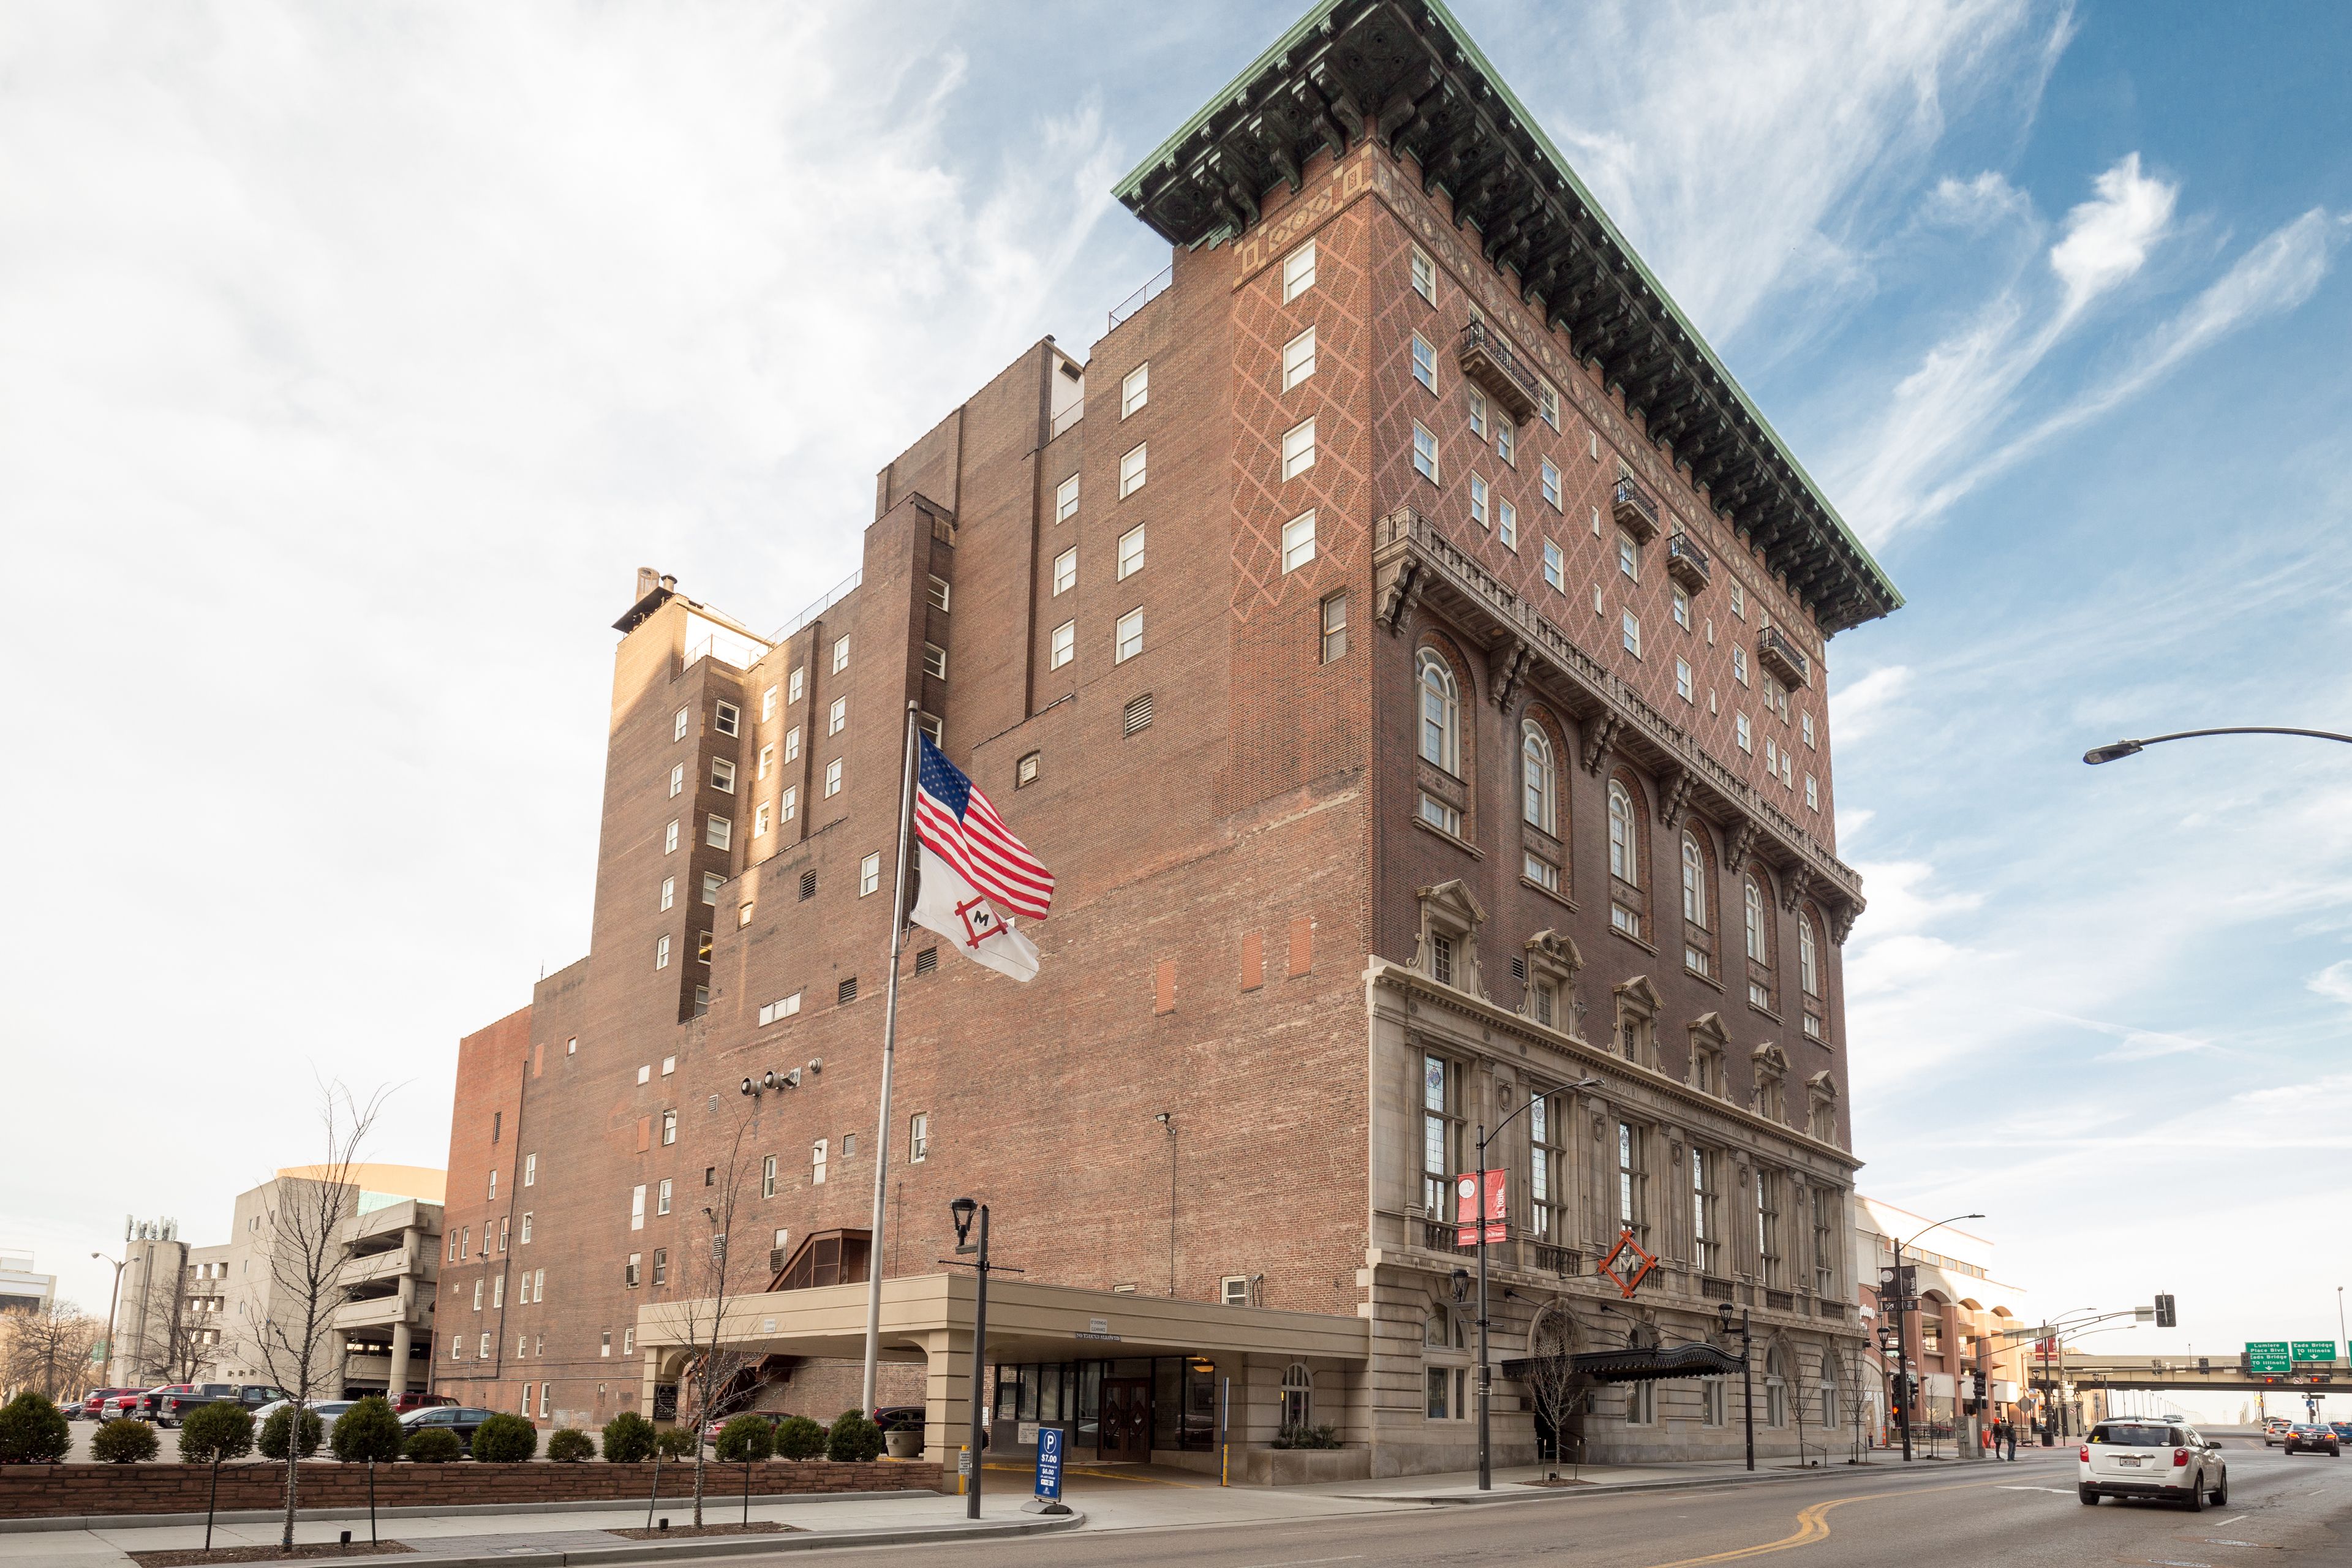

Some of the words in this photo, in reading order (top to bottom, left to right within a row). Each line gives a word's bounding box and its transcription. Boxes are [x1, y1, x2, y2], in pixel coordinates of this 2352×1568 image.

[974, 910, 989, 926] M
[1650, 1095, 1686, 1117] ATHLETIC
[1697, 1114, 1744, 1138] ASSOCIATION
[1618, 1254, 1636, 1272] M
[1047, 1435, 1054, 1450] P
[1041, 1453, 1057, 1463] $7.00
